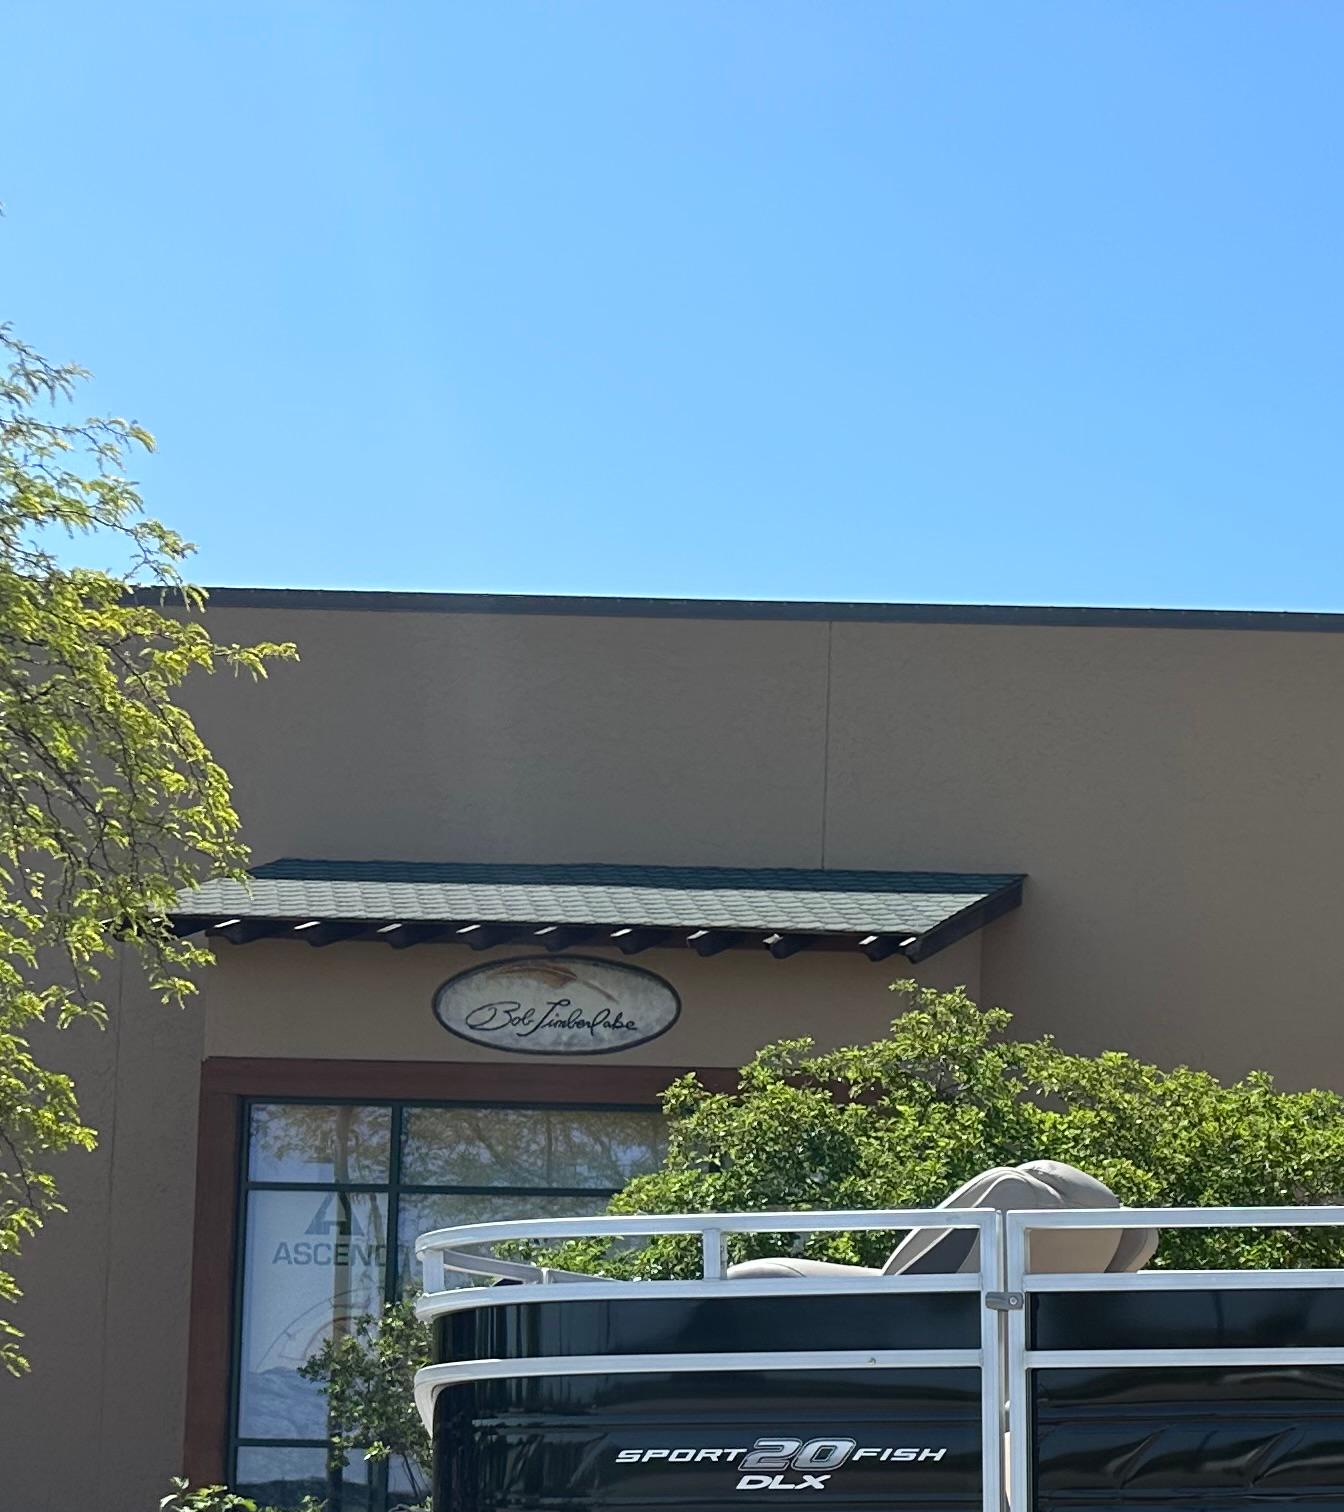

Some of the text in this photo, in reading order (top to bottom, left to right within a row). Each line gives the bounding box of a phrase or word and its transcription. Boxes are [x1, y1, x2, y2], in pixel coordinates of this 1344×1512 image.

[465, 1001, 535, 1032] Bob
[615, 1437, 947, 1471] SPORT 20 FISH
[735, 1474, 832, 1490] DLX
